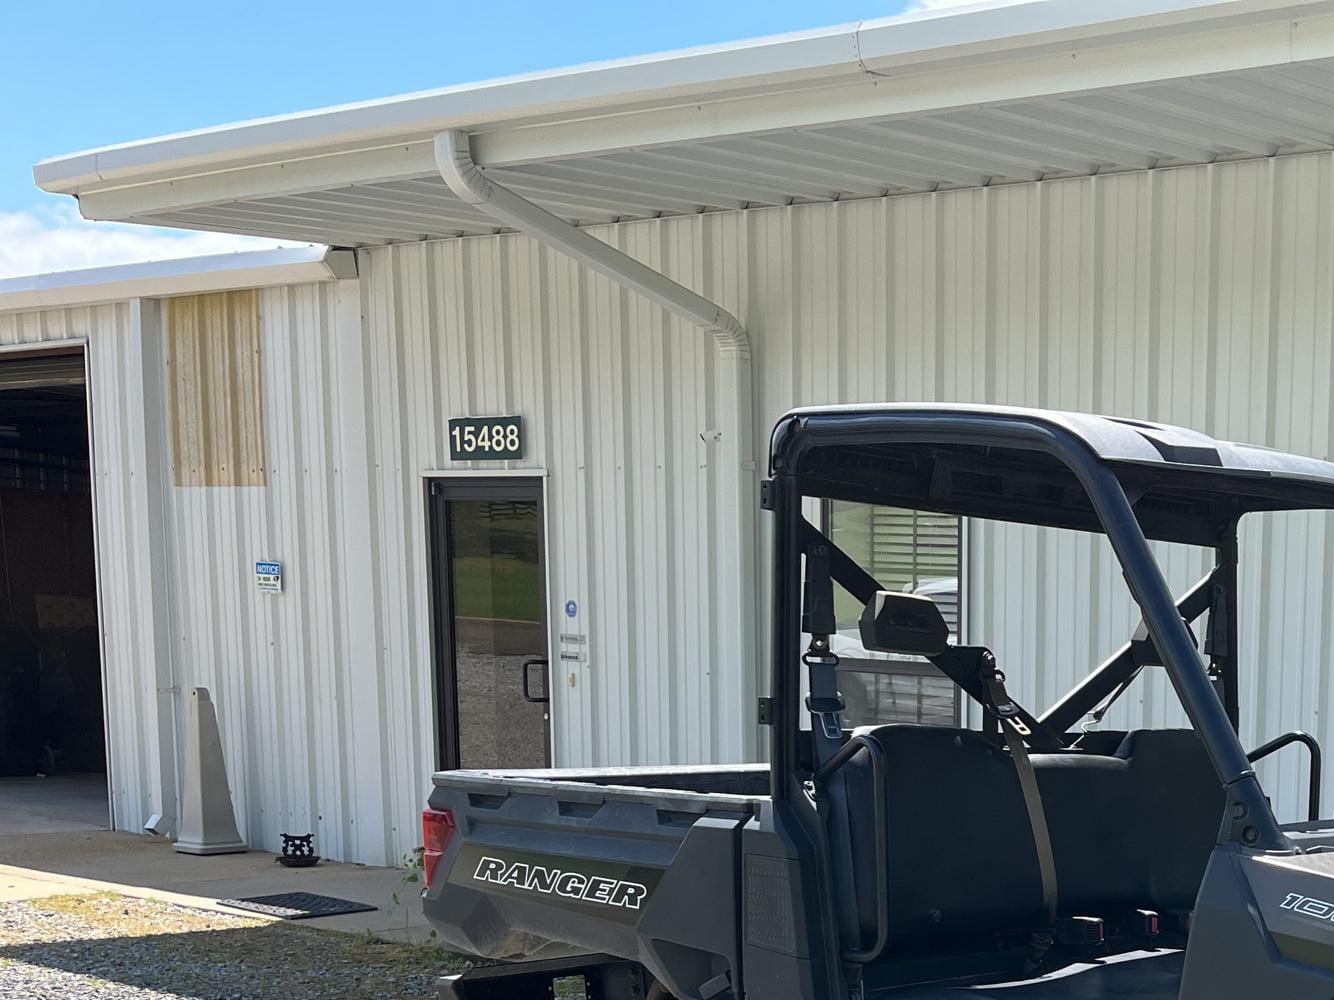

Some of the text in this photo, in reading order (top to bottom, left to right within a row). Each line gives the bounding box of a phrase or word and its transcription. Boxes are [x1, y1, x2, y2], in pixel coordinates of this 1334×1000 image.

[452, 424, 520, 452] 15488
[257, 564, 279, 574] NOTICE
[473, 857, 646, 909] RANGER
